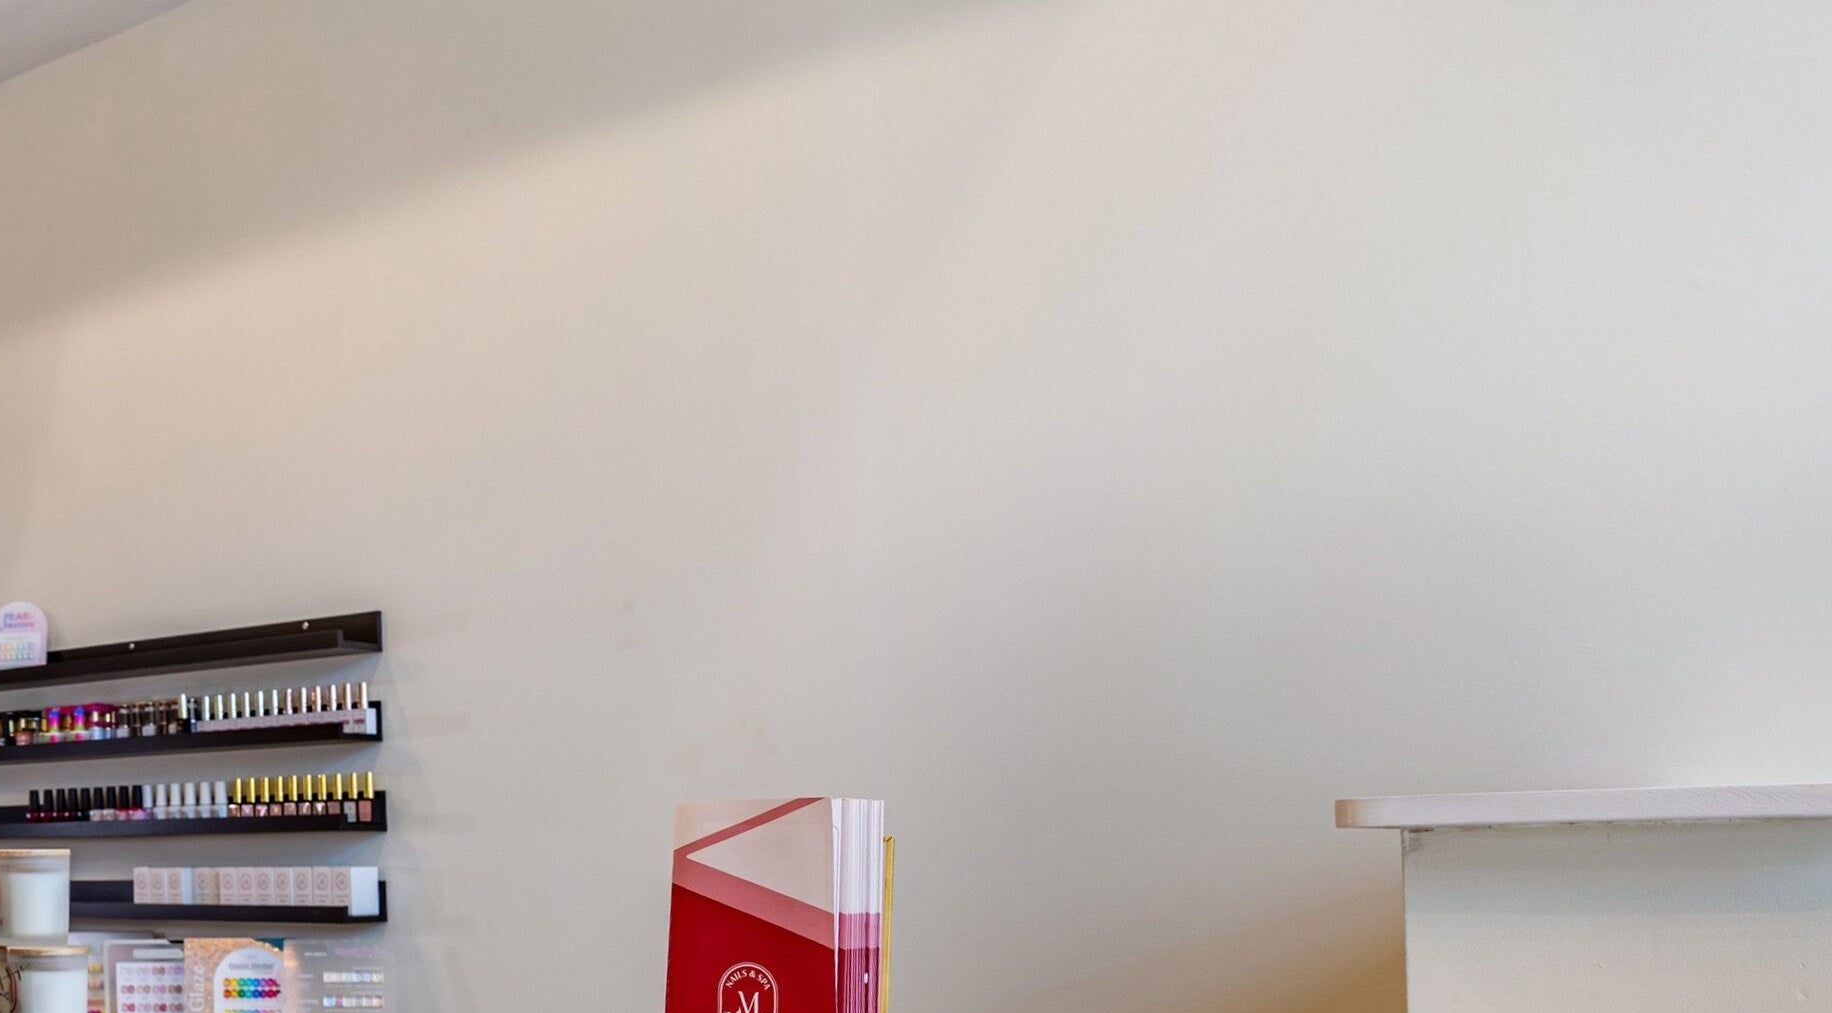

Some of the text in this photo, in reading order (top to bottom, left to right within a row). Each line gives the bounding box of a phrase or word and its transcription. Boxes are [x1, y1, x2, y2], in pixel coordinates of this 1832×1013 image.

[188, 964, 205, 1012] Glaze
[725, 969, 771, 990] NAILS & SPA
